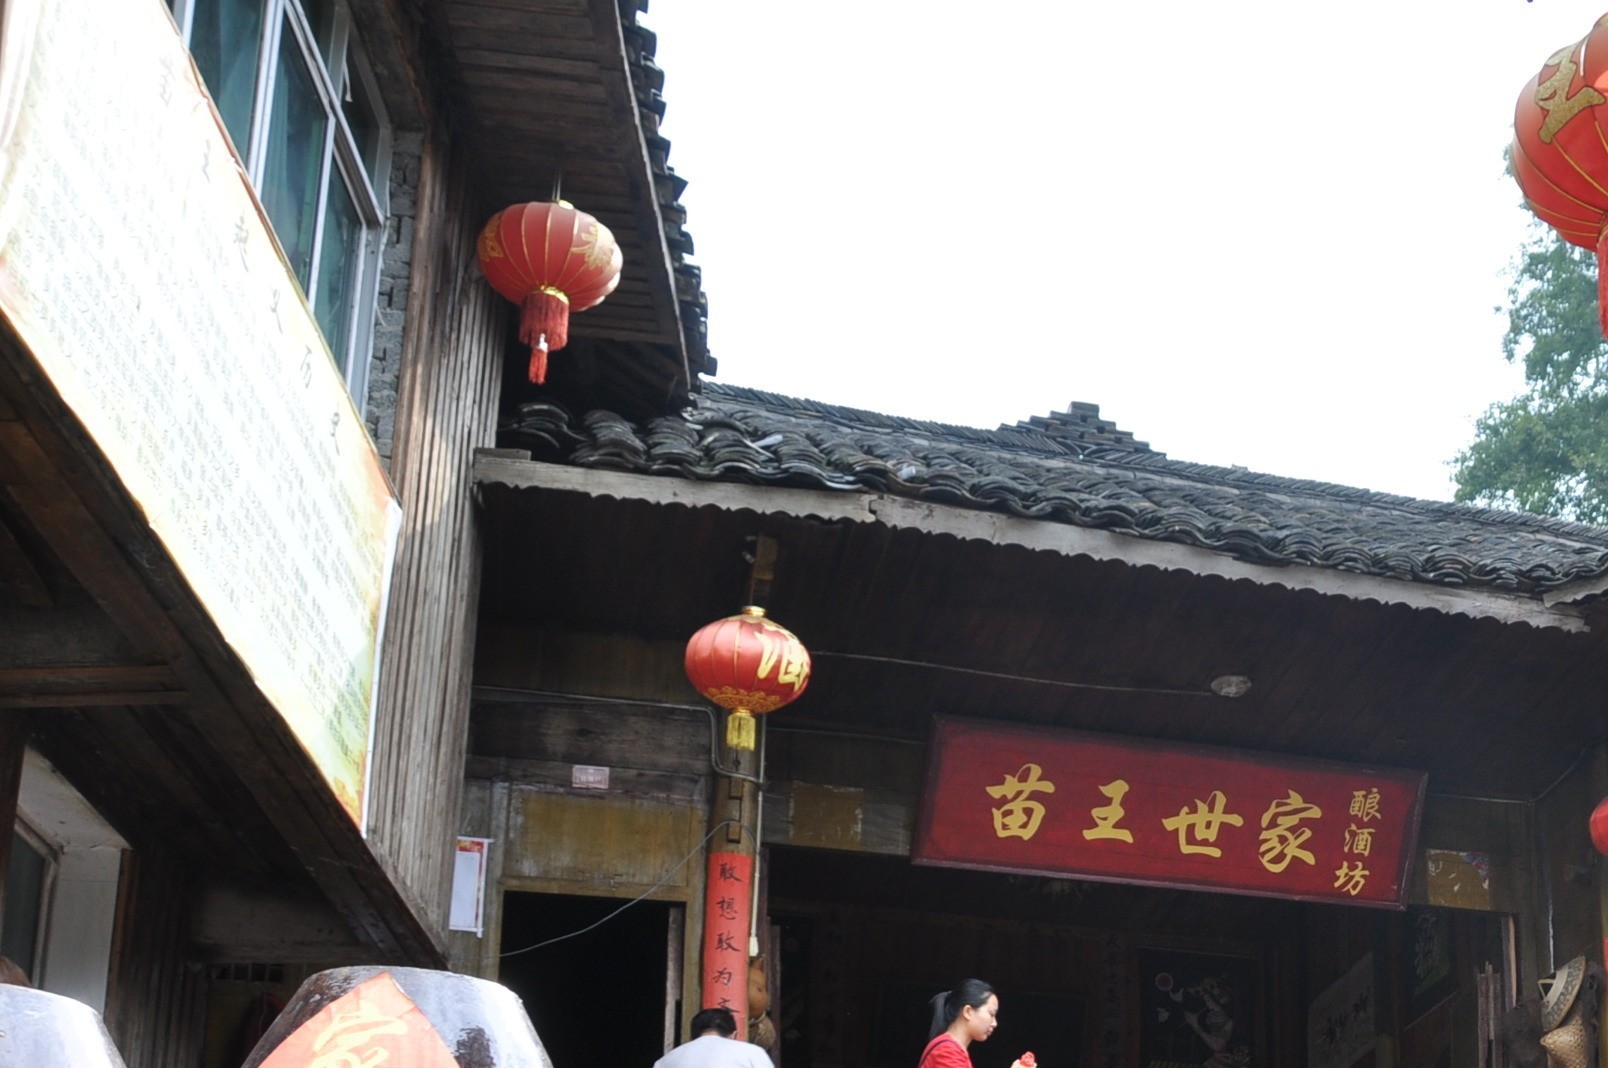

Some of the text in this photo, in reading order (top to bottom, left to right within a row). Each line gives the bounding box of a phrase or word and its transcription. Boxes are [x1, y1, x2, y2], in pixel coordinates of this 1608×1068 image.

[985, 763, 1322, 874] 苗王世家
[1334, 787, 1382, 896] 酿酒坊
